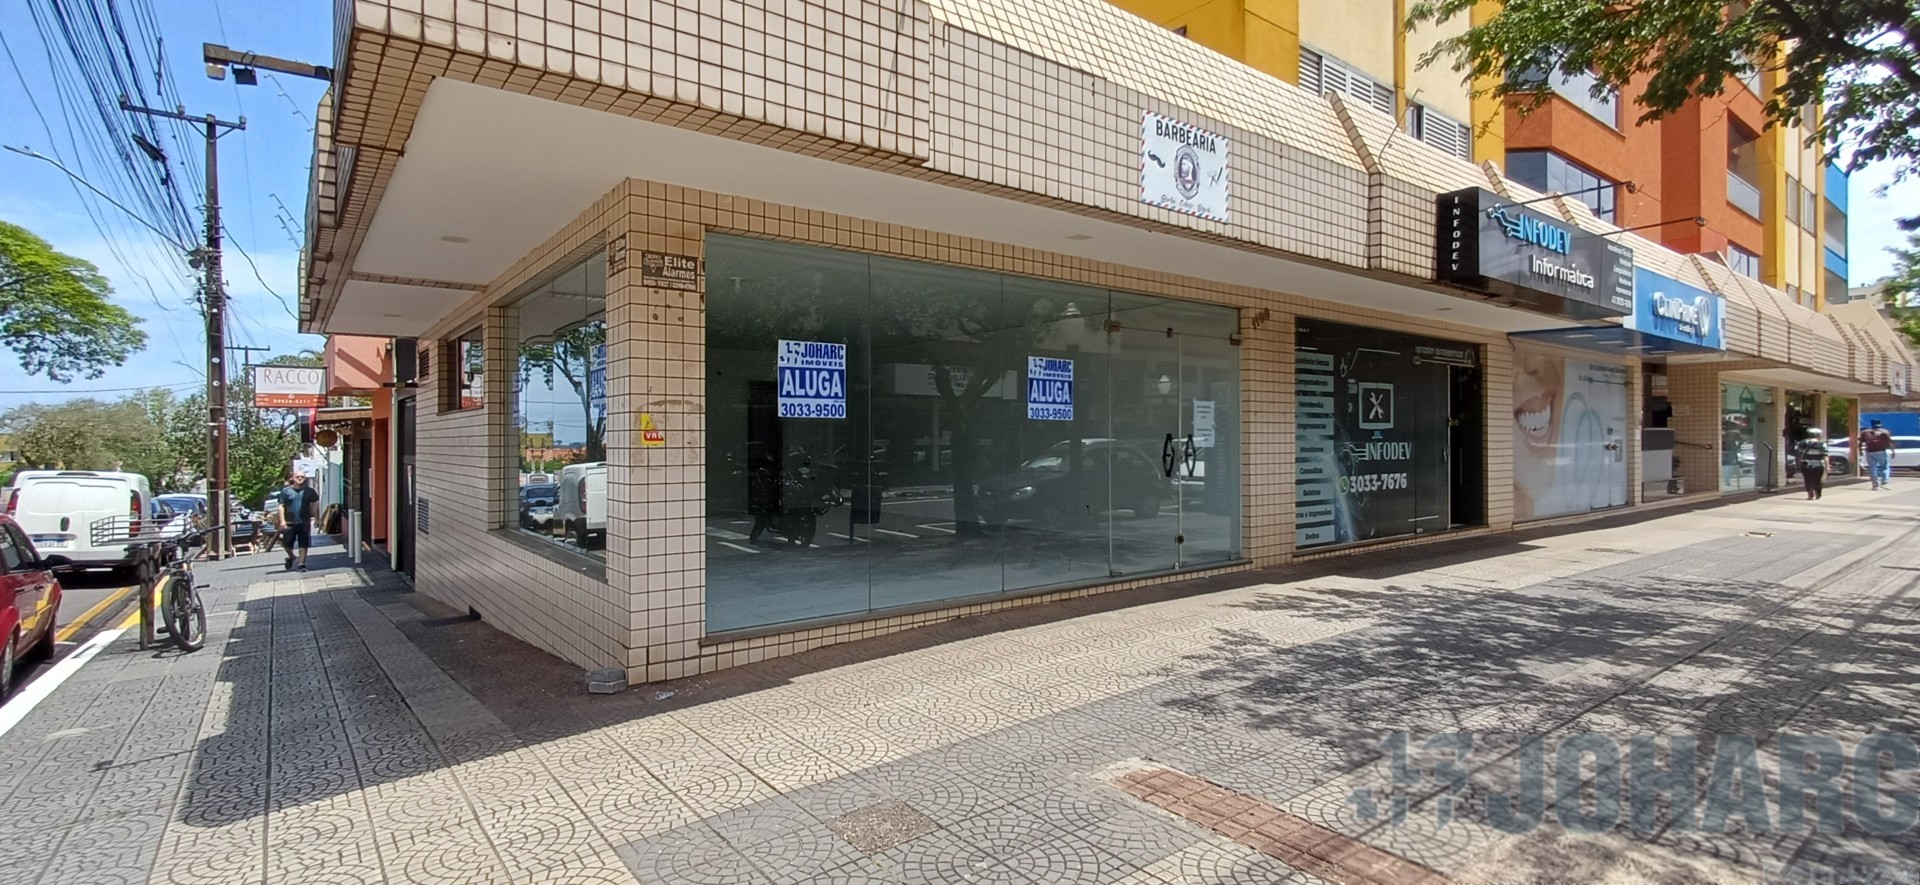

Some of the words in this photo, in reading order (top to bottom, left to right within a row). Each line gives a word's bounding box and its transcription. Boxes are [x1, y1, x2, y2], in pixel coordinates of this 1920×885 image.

[1155, 119, 1216, 154] BARBEARIA
[1451, 196, 1461, 271] INFODEV
[1520, 213, 1571, 255] INFODEV
[664, 256, 695, 269] Elite
[1533, 254, 1595, 289] Informática
[662, 266, 695, 280] Alarmes
[801, 343, 844, 360] JOHARC
[264, 368, 319, 384] RACCO
[1043, 360, 1071, 373] JOHARC
[782, 369, 842, 397] ALUGA
[1031, 380, 1071, 404] ALUGA
[781, 403, 844, 417] 3033-9500
[1030, 407, 1072, 419] 3033-9500
[1366, 442, 1412, 461] INFODEV
[1350, 473, 1407, 492] 3033-7676
